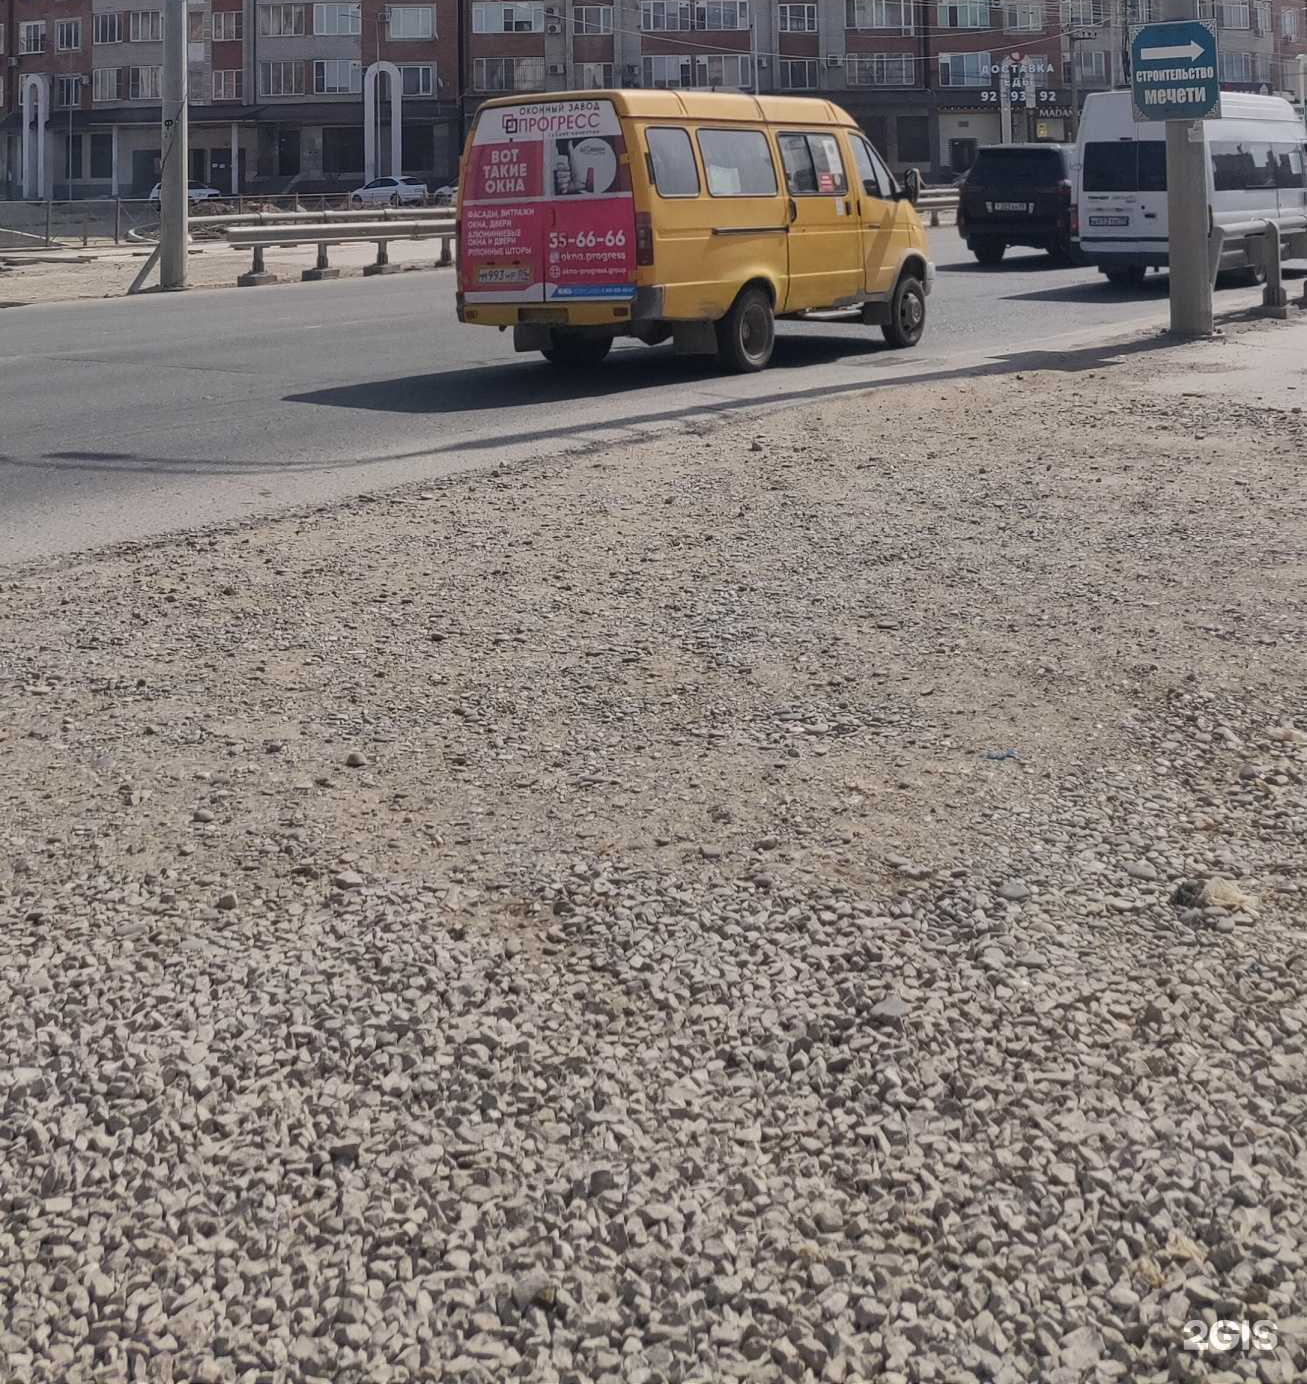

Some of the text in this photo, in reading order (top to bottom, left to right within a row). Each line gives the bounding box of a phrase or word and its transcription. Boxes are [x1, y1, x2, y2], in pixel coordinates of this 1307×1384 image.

[982, 64, 1055, 74] ДОСТАВКА
[1136, 66, 1214, 83] СТРОИТЕЛЬСТВО
[519, 101, 600, 115] ОКОННЫЙ ЗАВОД
[518, 113, 601, 133] ПРОГРЕСС
[491, 149, 519, 164] ВОТ
[482, 163, 528, 179] ТАКИЕ
[485, 178, 526, 194] ОКНА
